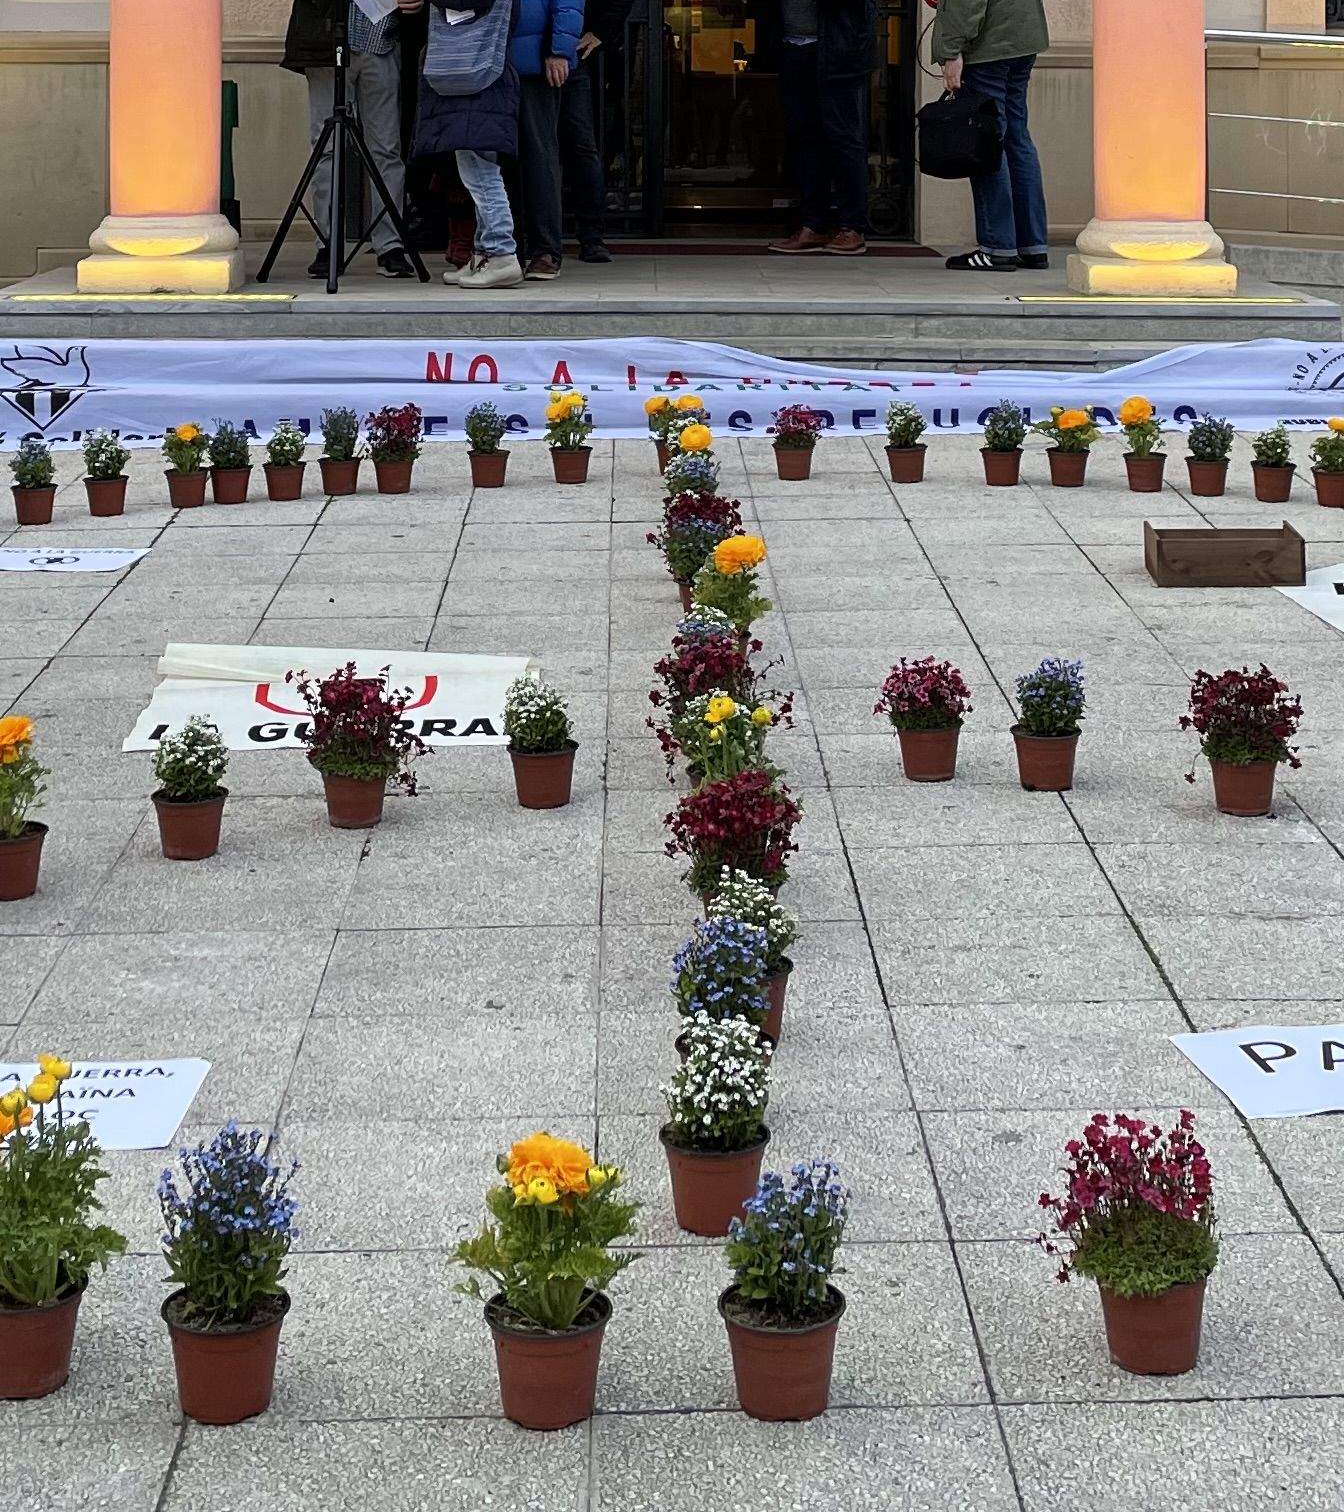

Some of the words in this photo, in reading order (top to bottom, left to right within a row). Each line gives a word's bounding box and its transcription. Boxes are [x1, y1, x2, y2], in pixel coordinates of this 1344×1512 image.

[425, 351, 498, 384] NO
[551, 360, 575, 385] A
[65, 1066, 175, 1080] UERRA,
